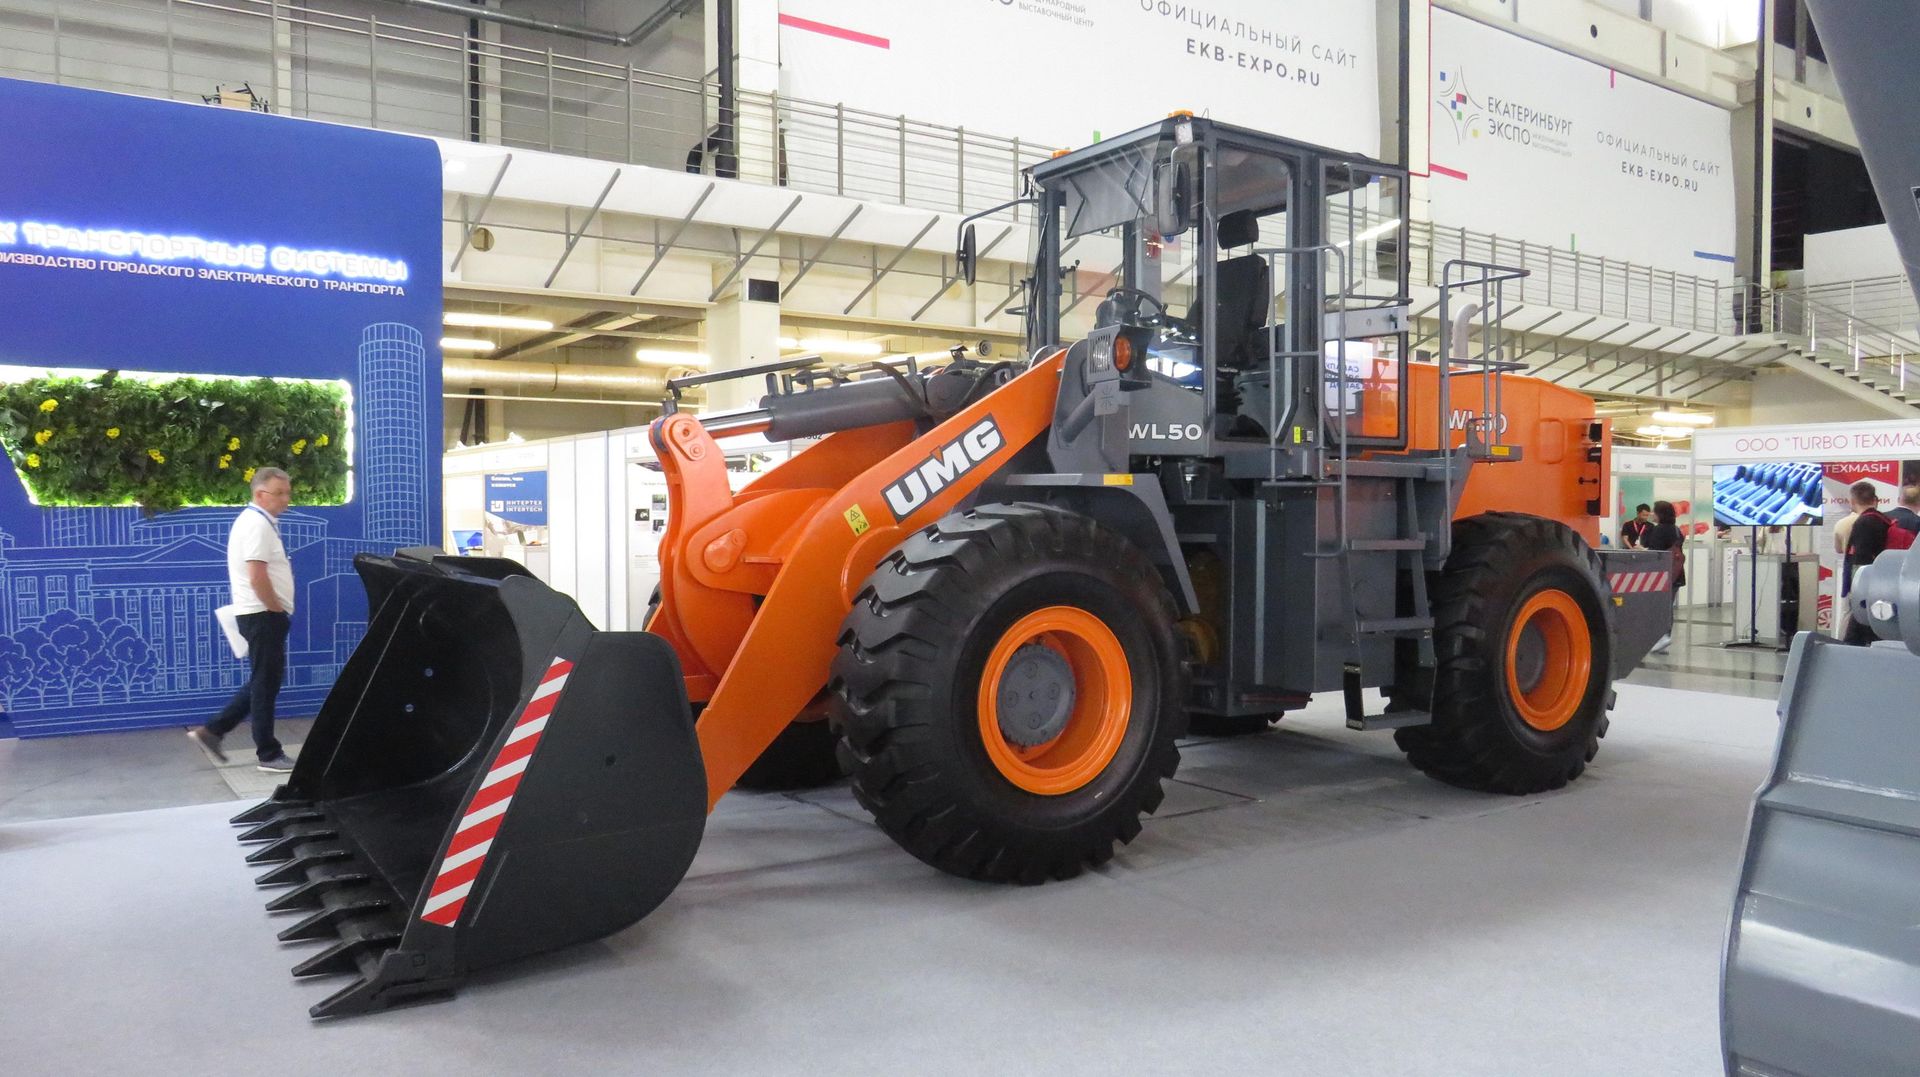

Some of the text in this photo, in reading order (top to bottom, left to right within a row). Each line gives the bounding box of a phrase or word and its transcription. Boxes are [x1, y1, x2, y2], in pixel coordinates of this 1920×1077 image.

[1018, 2, 1095, 28] ВЫСТАВОЧНЫЙ ЦЕНТР
[1140, 0, 1357, 69] ОФИЦИАЛЬНЫЙ САЙТ
[1186, 38, 1320, 87] EKB-EXPO.RU
[1487, 96, 1573, 136] ЕКАТЕРИНБУРГ
[1488, 118, 1531, 145] ЭКСПО
[1596, 131, 1688, 167] ОФИЦИАЛЬНЫЙ
[1692, 159, 1720, 176] САЙТ
[1621, 161, 1698, 192] EKB-EXPO.RU
[24, 224, 265, 266] ТРАНСПОРТНЫЕ
[273, 247, 406, 279] СИСТЕМЫ
[100, 259, 195, 278] ГОРОДСКОГО
[198, 269, 319, 289] ЭЛЕКТРИЧЕСКОГО
[323, 279, 405, 296] ТРАНСПОРТА
[1128, 423, 1203, 440] WL50
[885, 420, 1001, 516] UMG
[1823, 463, 1890, 473] TEXMASH
